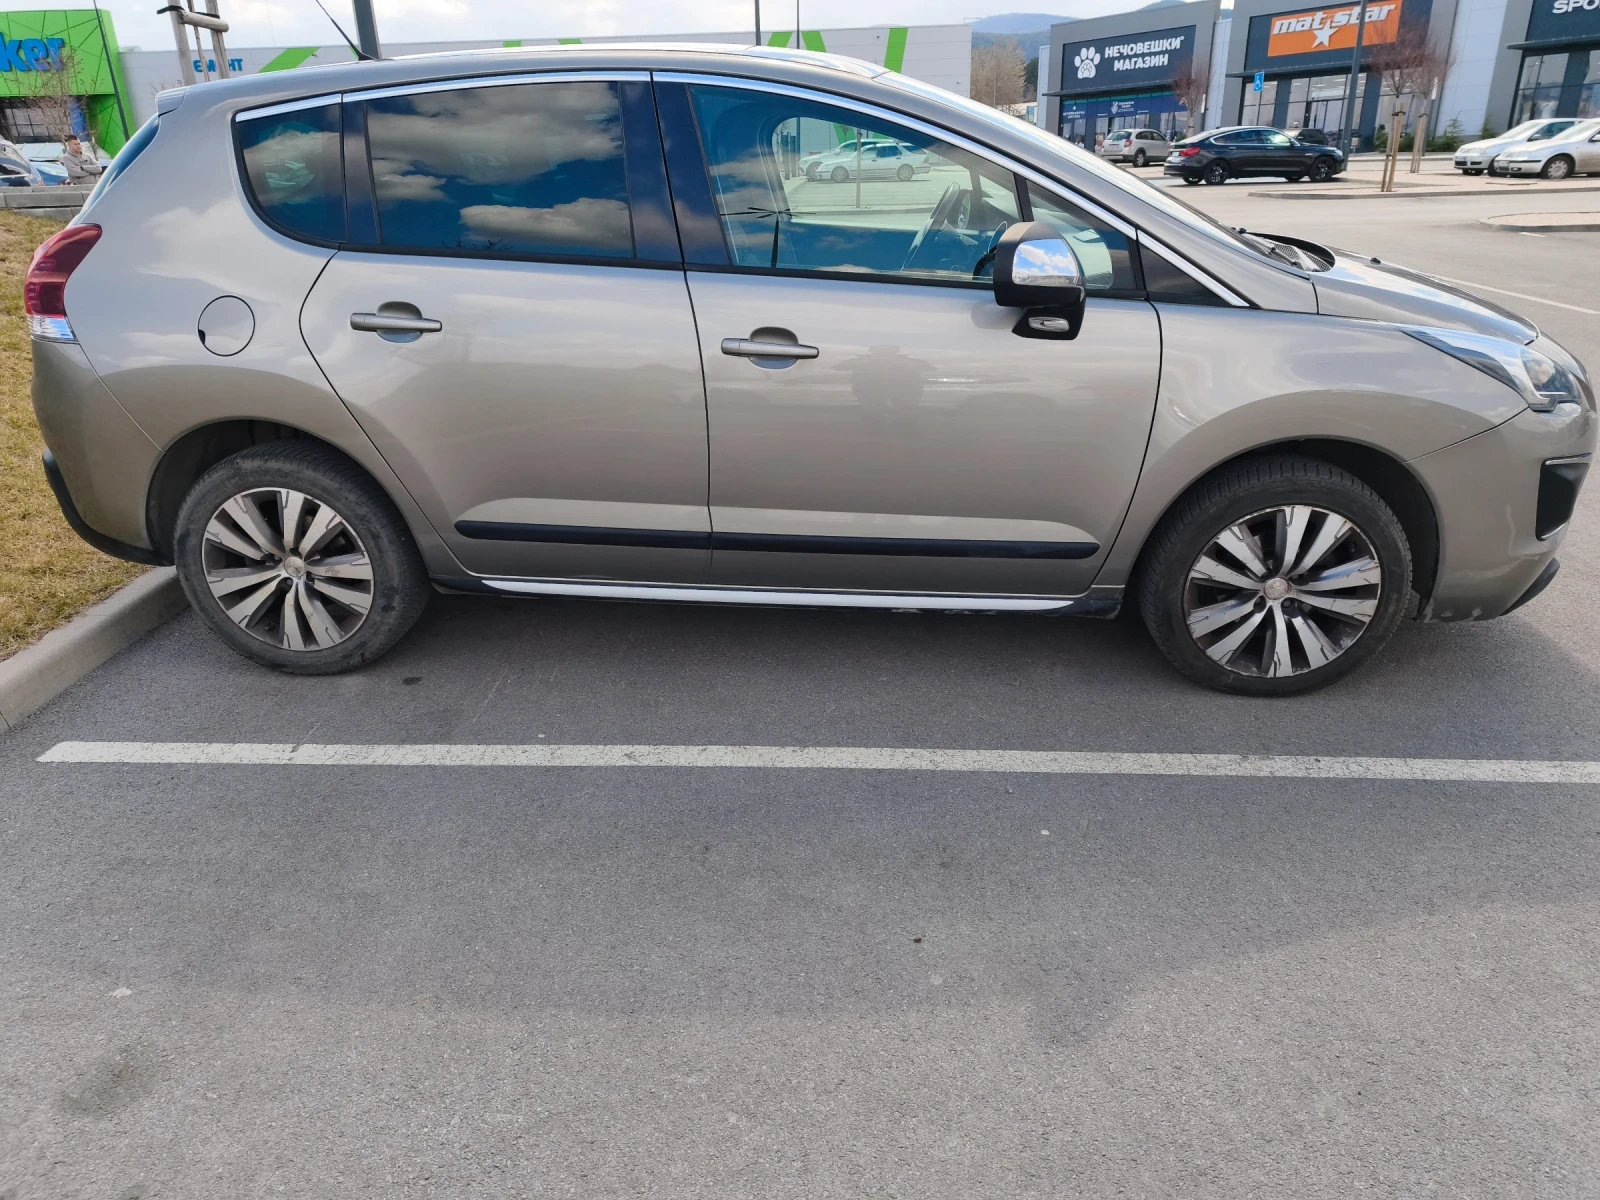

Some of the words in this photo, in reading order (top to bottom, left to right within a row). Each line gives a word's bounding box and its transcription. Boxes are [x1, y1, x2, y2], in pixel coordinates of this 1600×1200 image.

[1552, 0, 1600, 14] SPO
[1272, 11, 1326, 35] mat
[1331, 4, 1397, 27] star
[1104, 37, 1182, 59] НЕЧОВЕШКИ
[1113, 53, 1169, 72] МАГАЗИН
